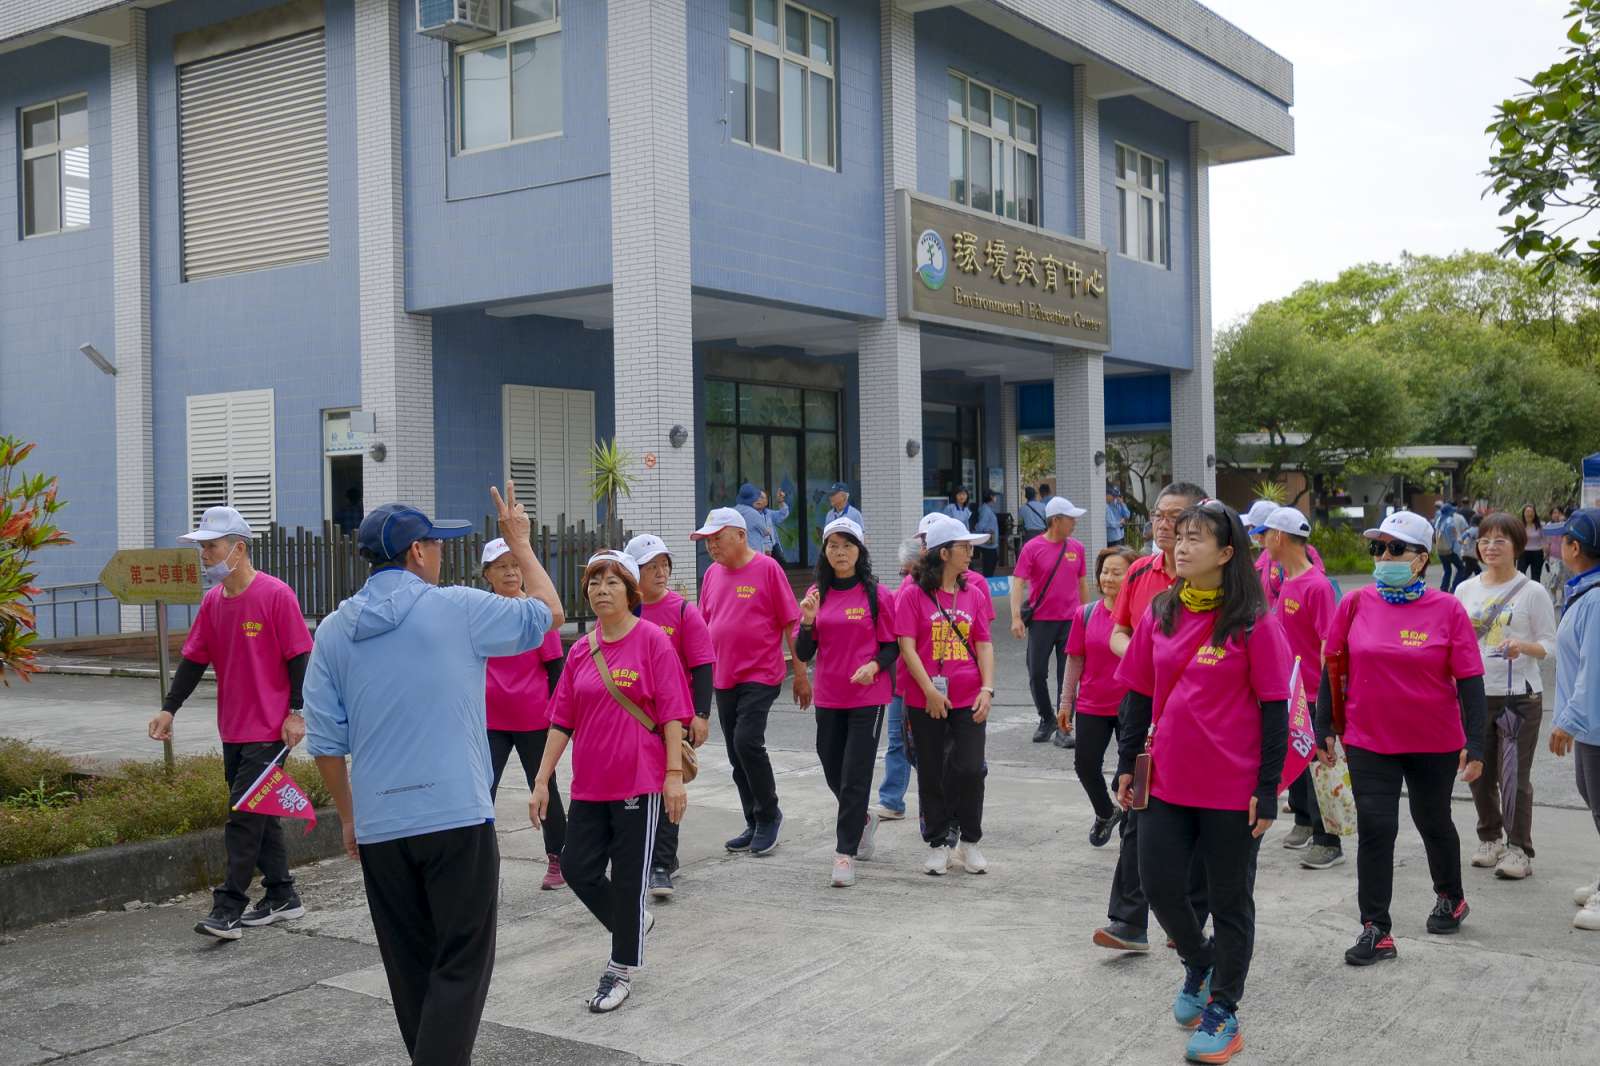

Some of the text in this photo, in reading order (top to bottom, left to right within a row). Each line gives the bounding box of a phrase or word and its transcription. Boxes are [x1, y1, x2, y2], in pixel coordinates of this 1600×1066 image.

[952, 231, 1105, 297] 環境教育中心
[953, 286, 1104, 331] Environmental Education Center
[130, 563, 198, 584] 第二停車場
